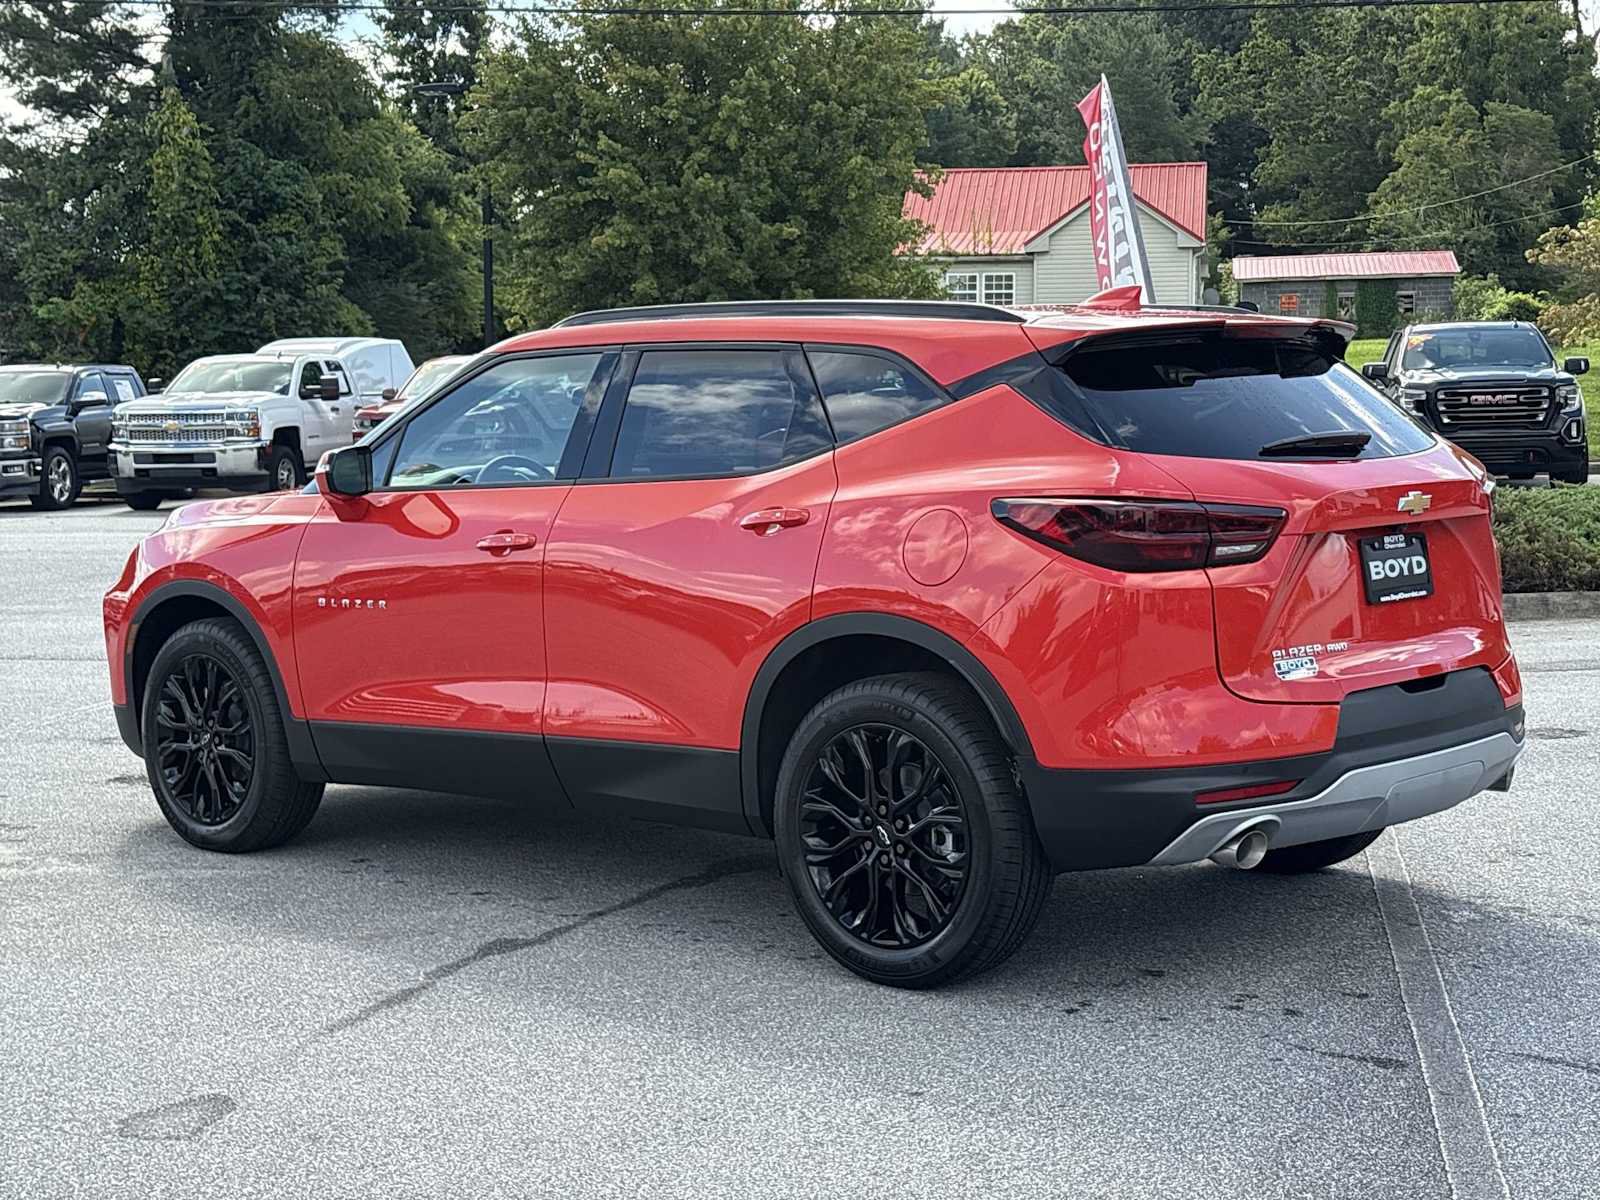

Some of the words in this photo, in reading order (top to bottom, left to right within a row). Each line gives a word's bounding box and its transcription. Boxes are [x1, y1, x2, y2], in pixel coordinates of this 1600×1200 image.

[1470, 394, 1517, 405] GMC
[1384, 534, 1405, 544] BOYD
[1368, 555, 1427, 581] BOYD
[318, 597, 387, 609] BLAZER
[1272, 643, 1321, 661] BLAZER
[1326, 641, 1348, 653] AWD
[1280, 658, 1312, 671] BOYD
